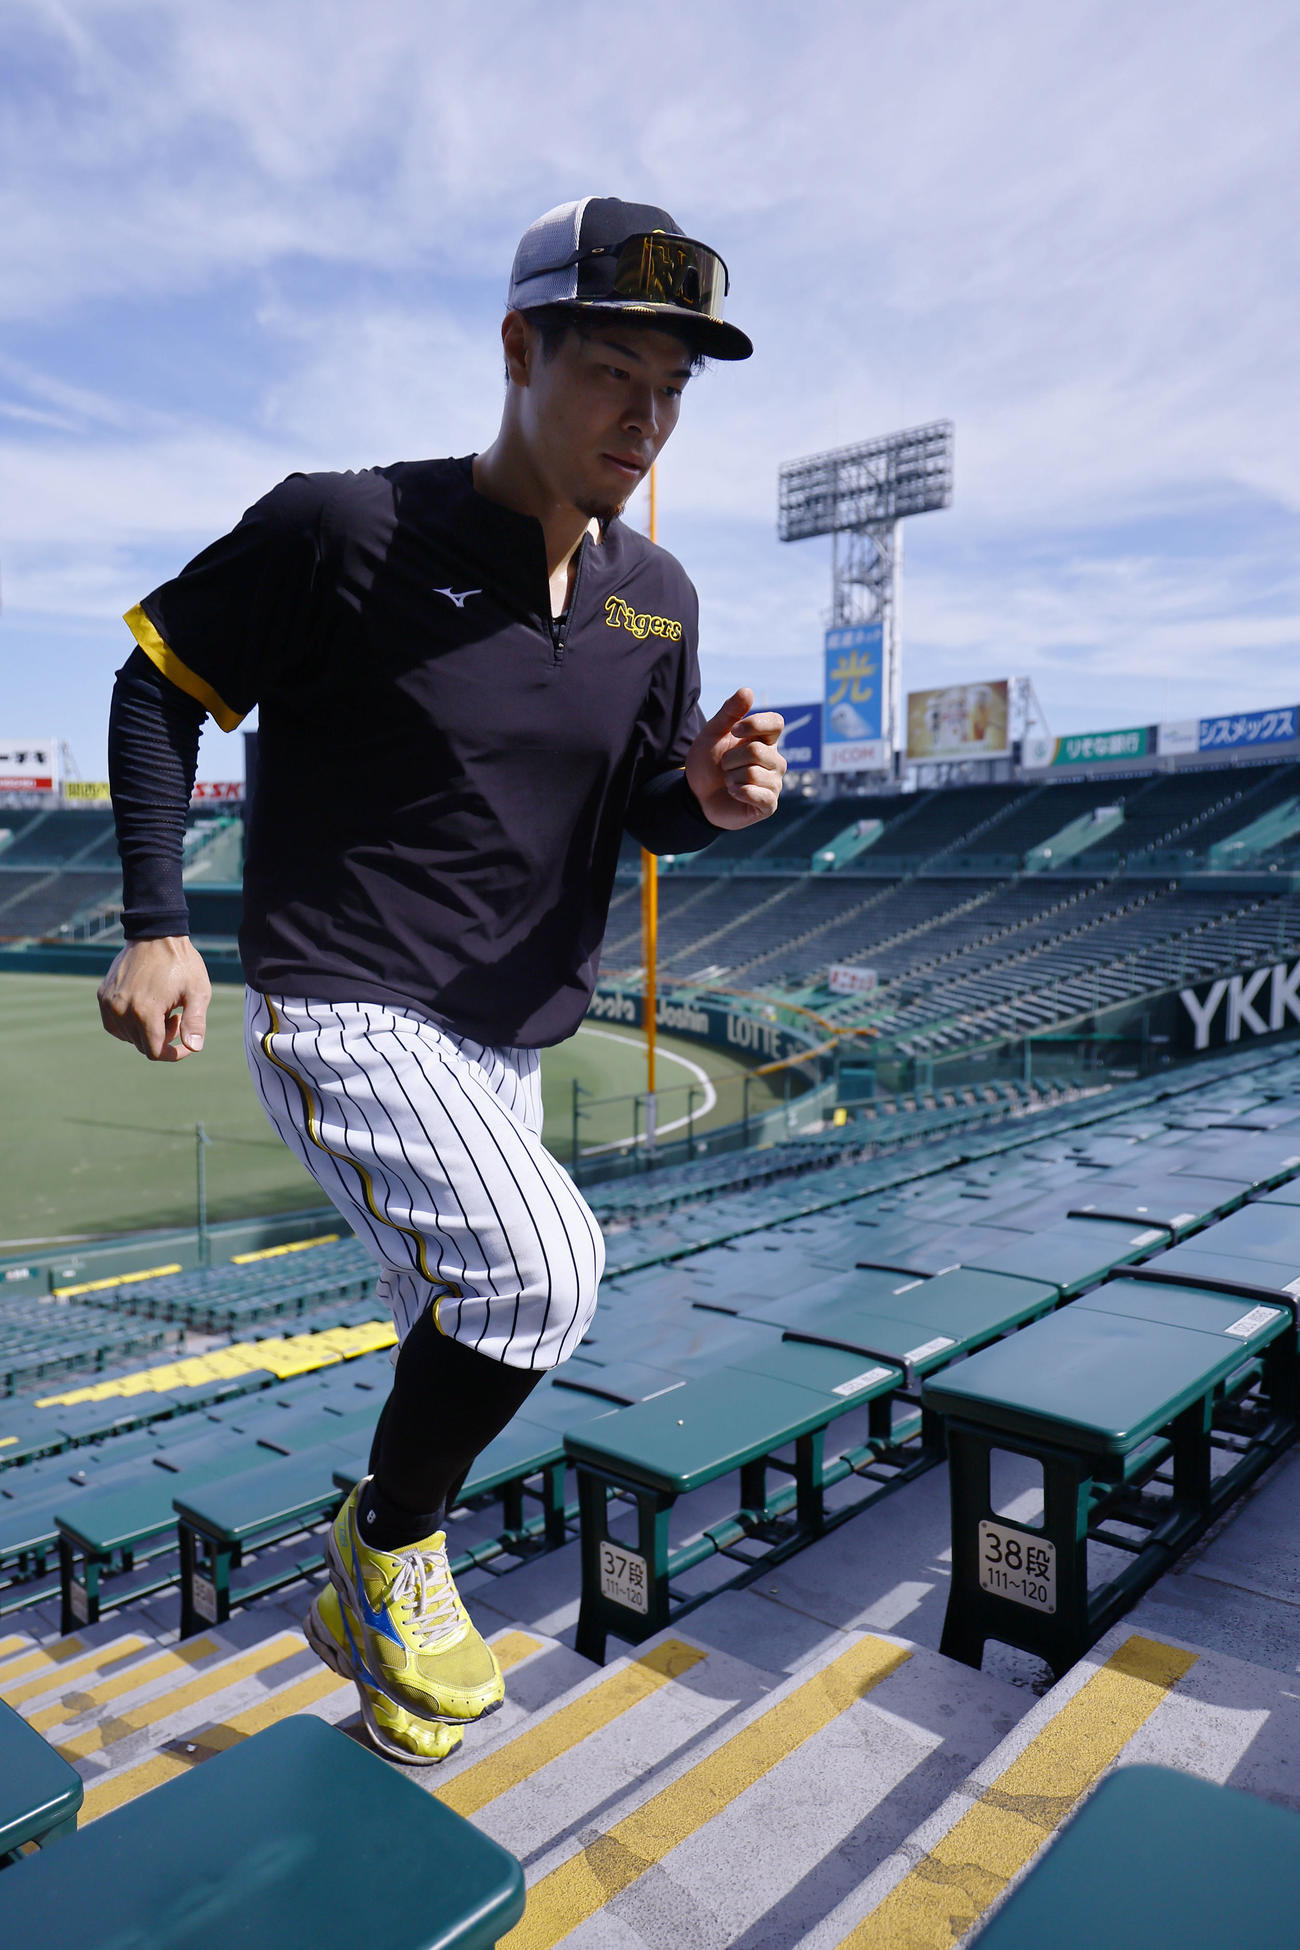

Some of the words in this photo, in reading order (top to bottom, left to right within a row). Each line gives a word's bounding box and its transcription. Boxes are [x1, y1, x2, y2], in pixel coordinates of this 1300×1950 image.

[605, 595, 682, 641] Tigers
[828, 650, 880, 705] 光
[1200, 711, 1295, 746] シスメックス
[193, 783, 241, 799] SSK
[656, 999, 709, 1035] Joshin
[1180, 959, 1300, 1050] YKK
[727, 1013, 782, 1060] LOTTE
[604, 1551, 644, 1589] 37段
[985, 1533, 1051, 1582] 38段
